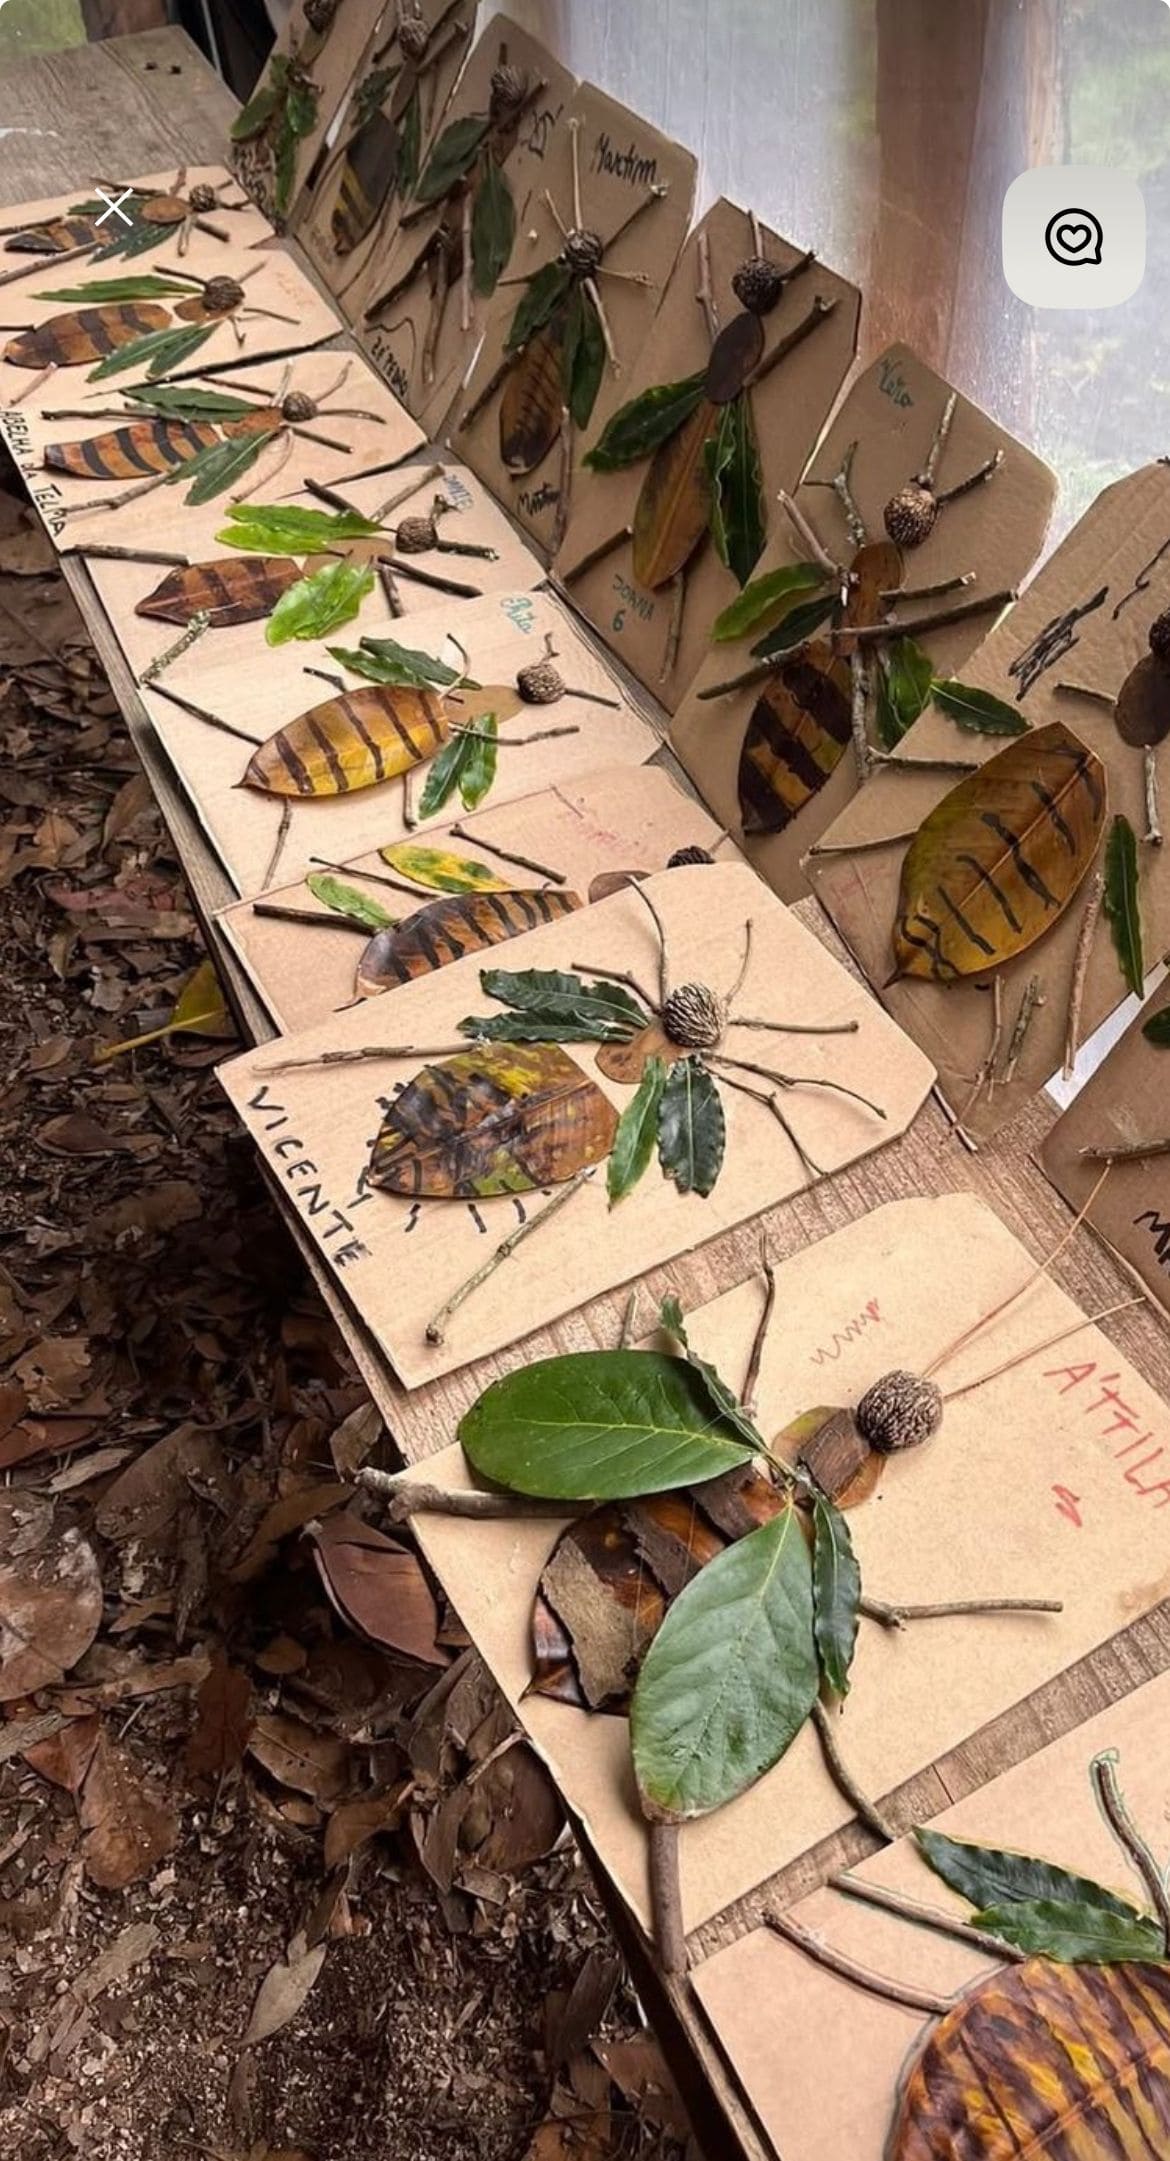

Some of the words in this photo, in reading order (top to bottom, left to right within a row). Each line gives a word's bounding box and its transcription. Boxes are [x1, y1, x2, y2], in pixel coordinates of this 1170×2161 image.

[0, 410, 34, 456] ABELHA
[33, 483, 68, 538] TELMA
[612, 609, 627, 633] 6
[247, 1085, 373, 1267] VICENTE
